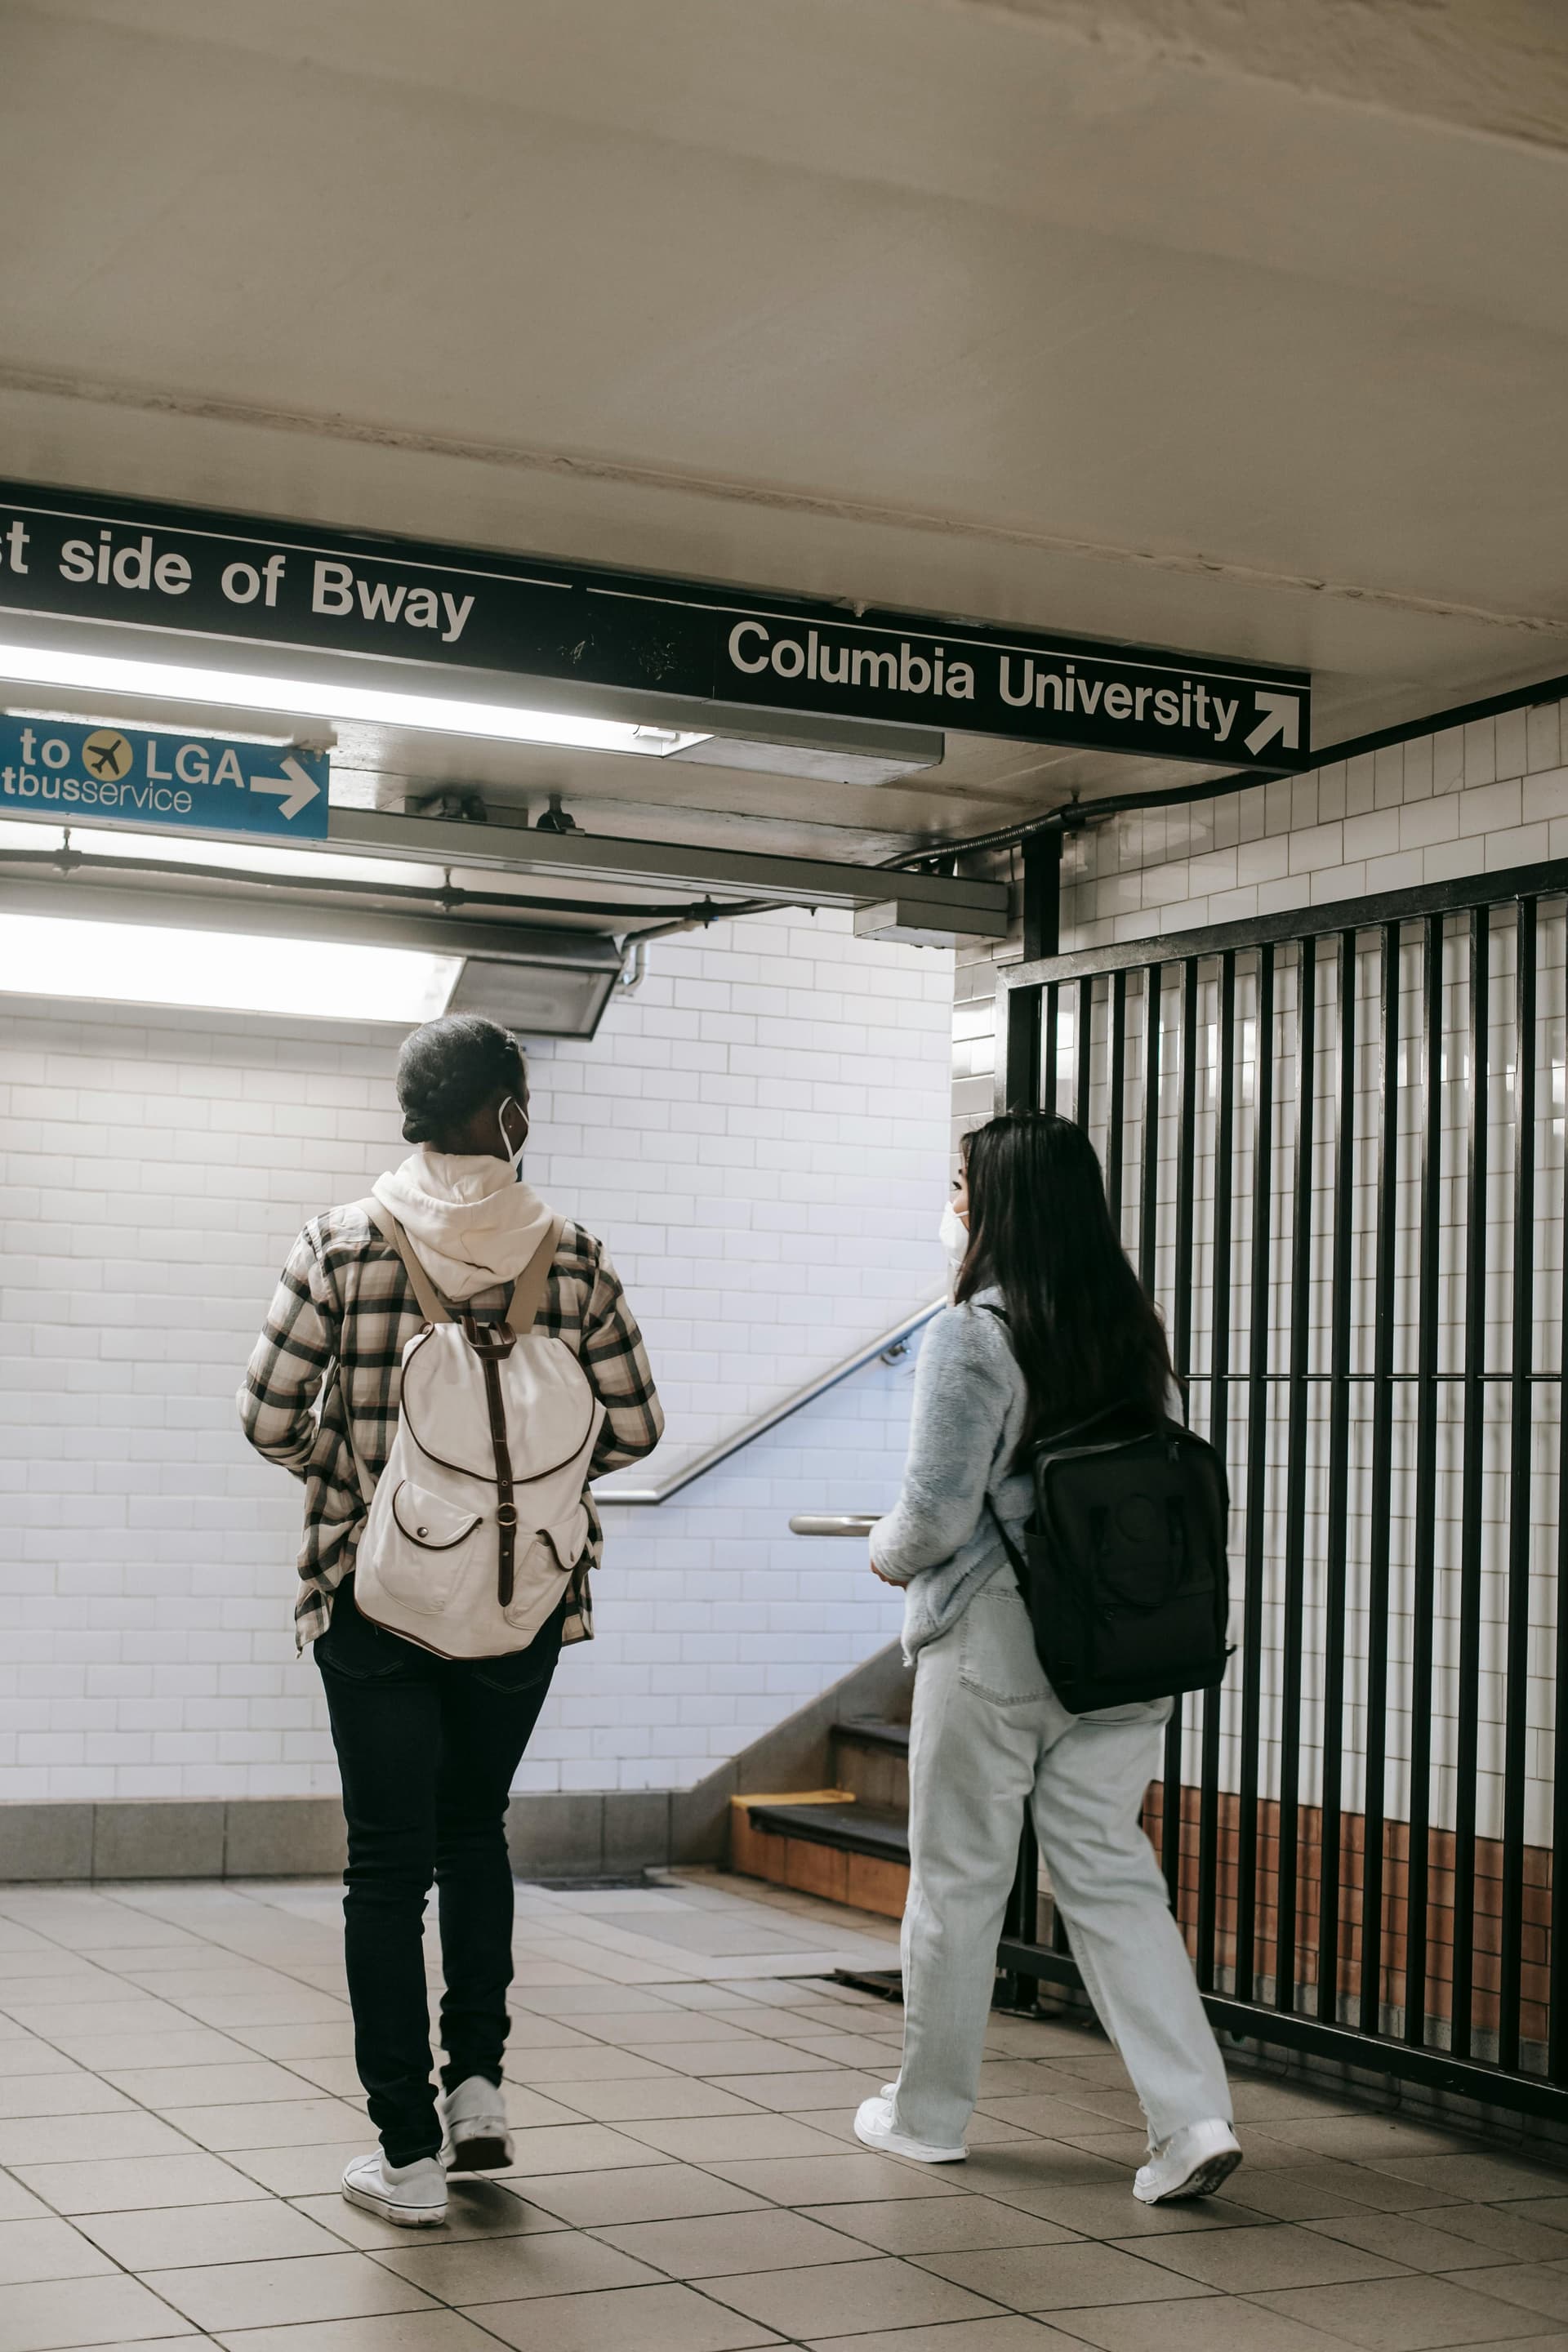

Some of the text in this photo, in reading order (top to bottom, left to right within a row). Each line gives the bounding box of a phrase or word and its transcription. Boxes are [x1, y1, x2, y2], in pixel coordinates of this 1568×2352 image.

[0, 521, 475, 643] t side of Bway
[728, 621, 1239, 742] Columbia University
[20, 728, 245, 788] to LGA
